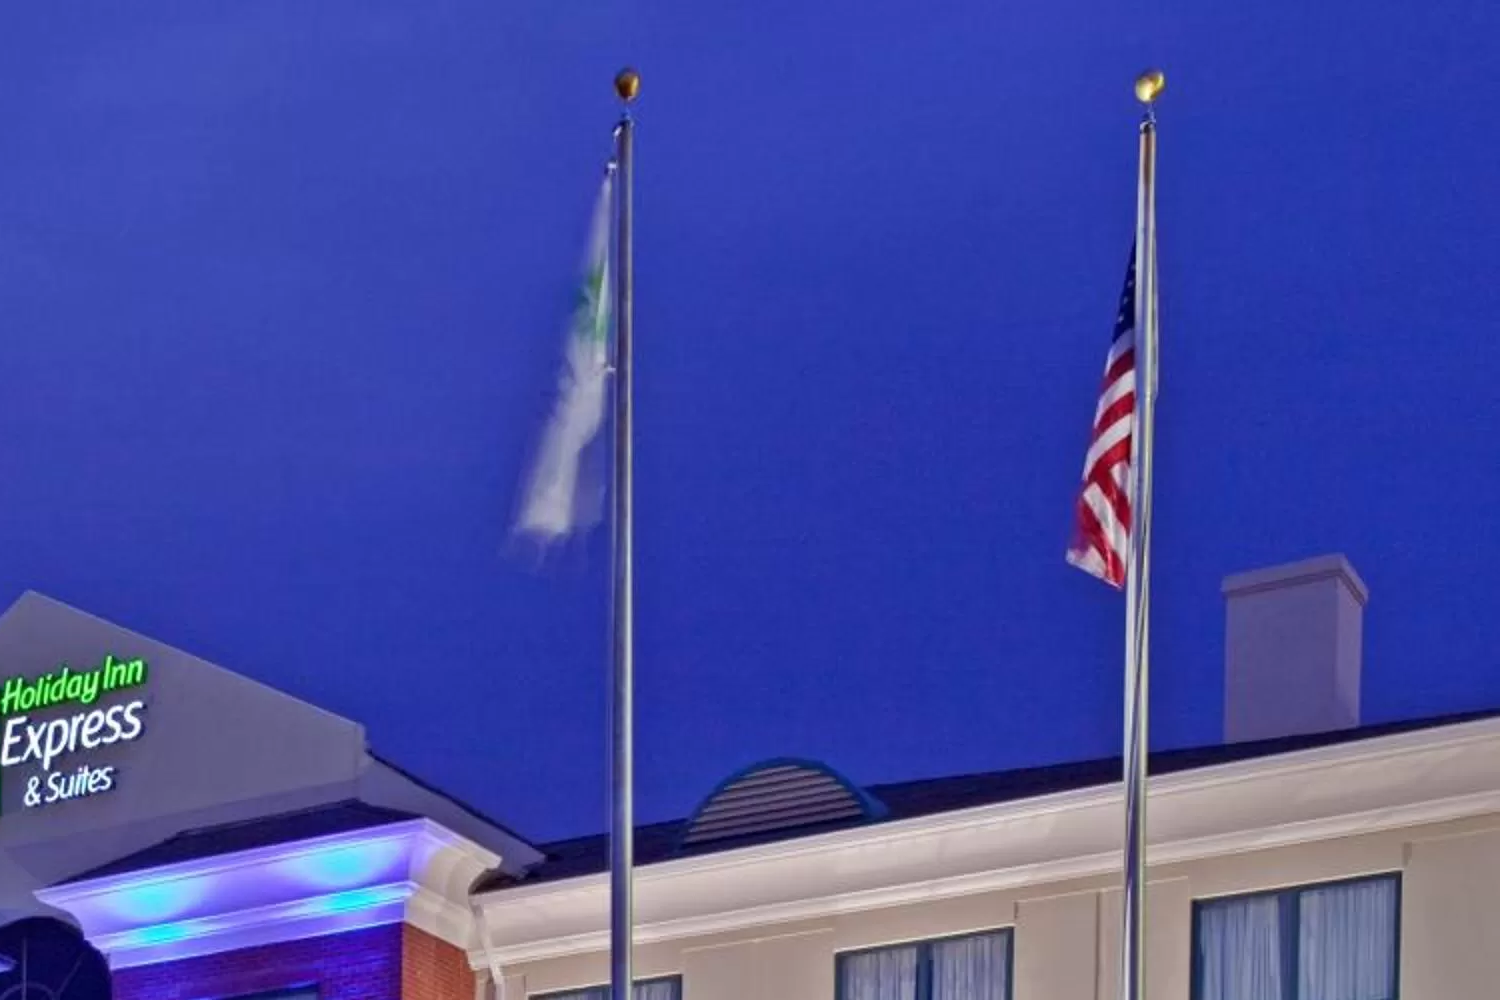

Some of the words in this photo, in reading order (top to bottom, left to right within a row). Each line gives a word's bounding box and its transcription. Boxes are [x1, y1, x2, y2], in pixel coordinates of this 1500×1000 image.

[2, 666, 99, 713] Holiday
[102, 655, 144, 690] Inn
[1, 701, 144, 770] Express
[24, 777, 41, 807] &
[46, 766, 113, 803] Suites
